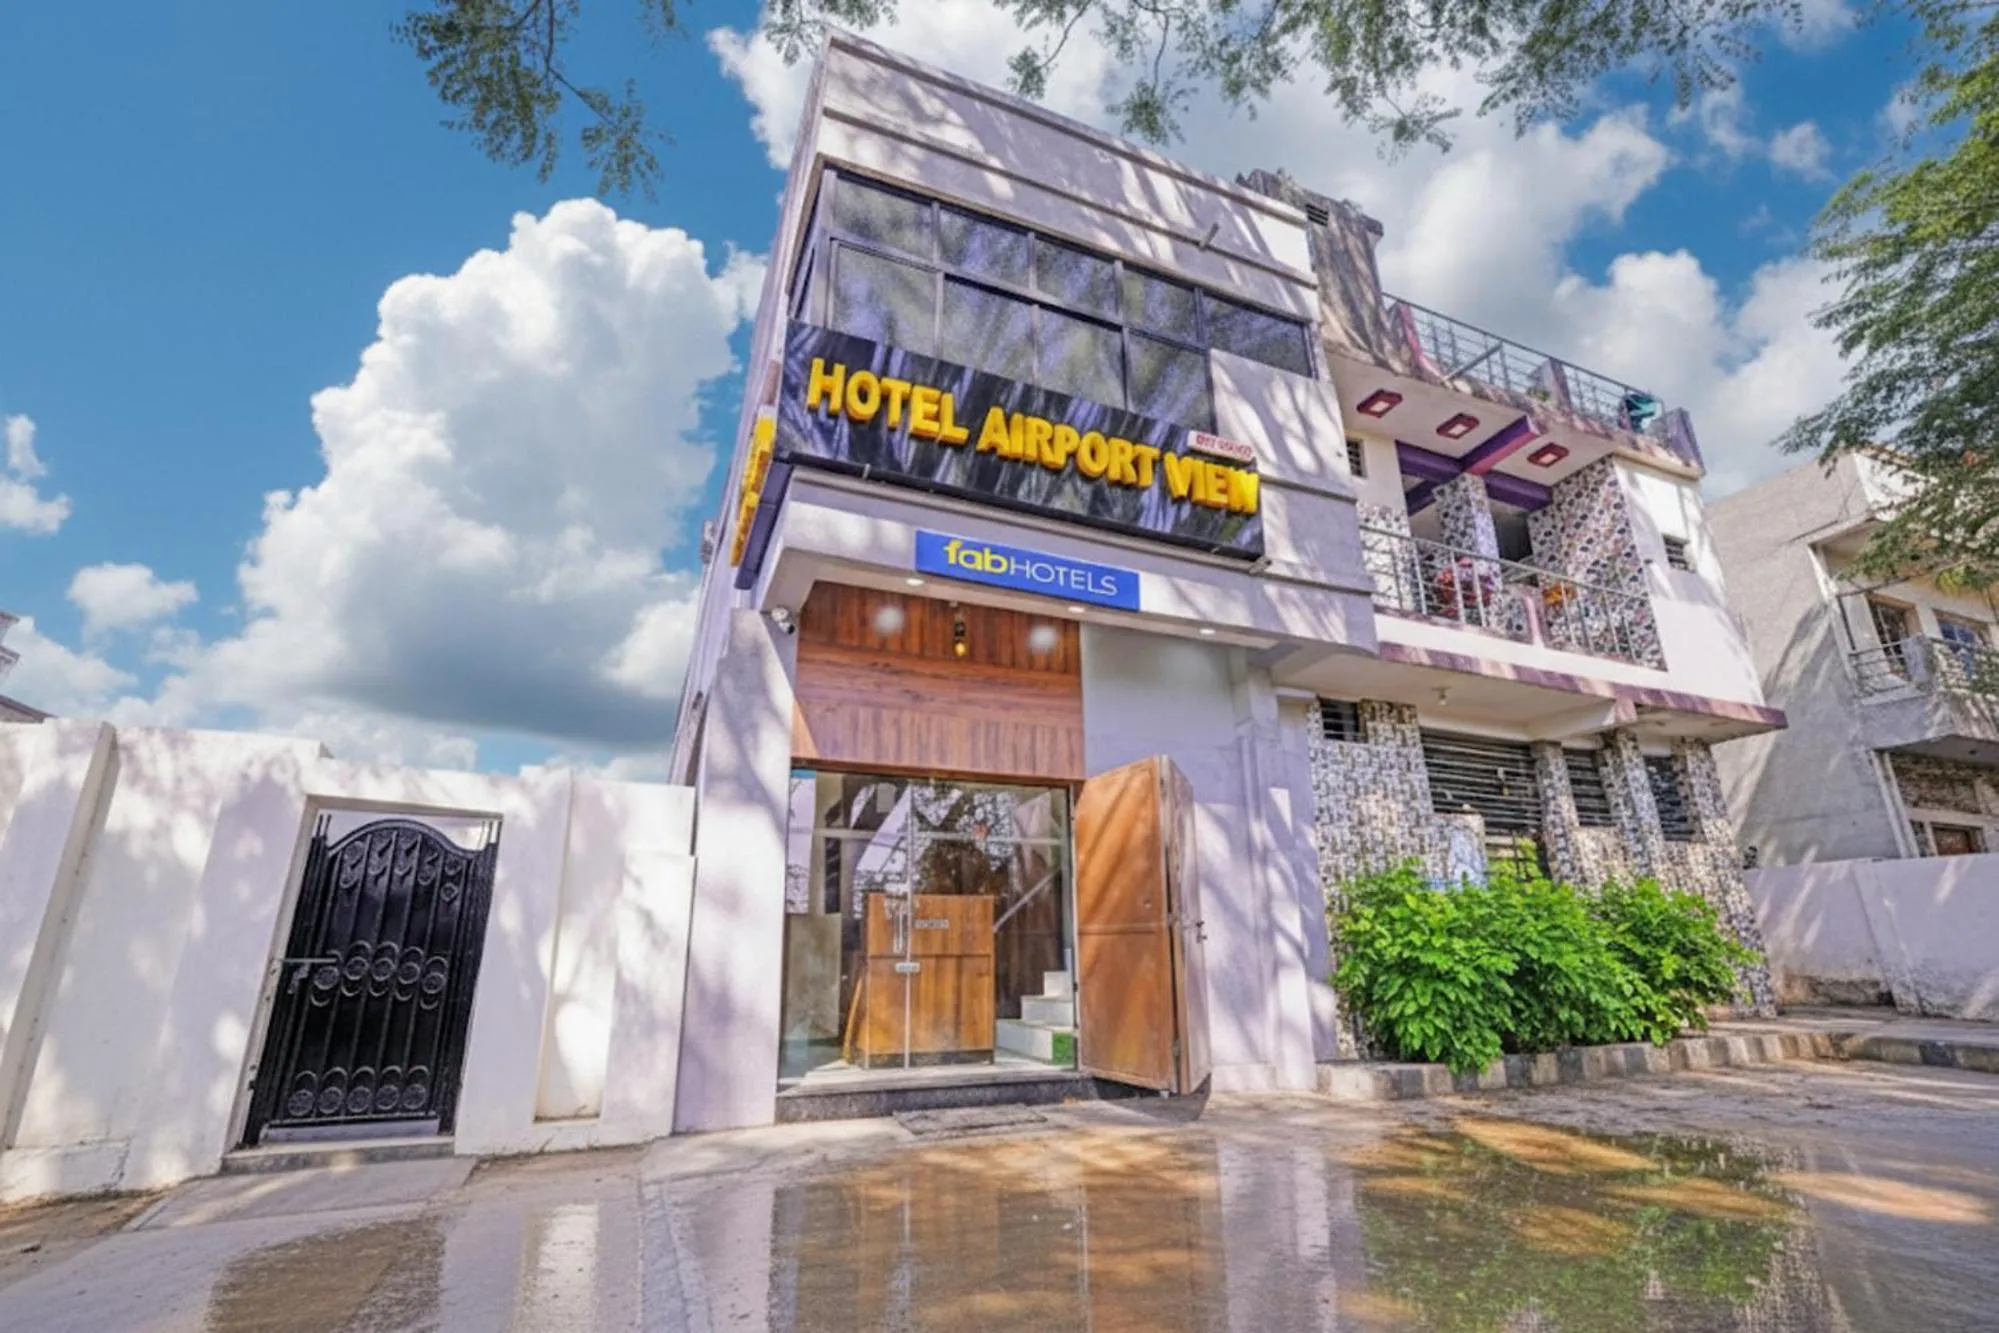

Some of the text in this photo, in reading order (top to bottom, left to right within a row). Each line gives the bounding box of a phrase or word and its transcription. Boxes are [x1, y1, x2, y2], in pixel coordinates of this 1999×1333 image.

[807, 357, 1260, 513] HOTEL AIRPORT VIEW
[943, 539, 1118, 596] fabHOTELS
